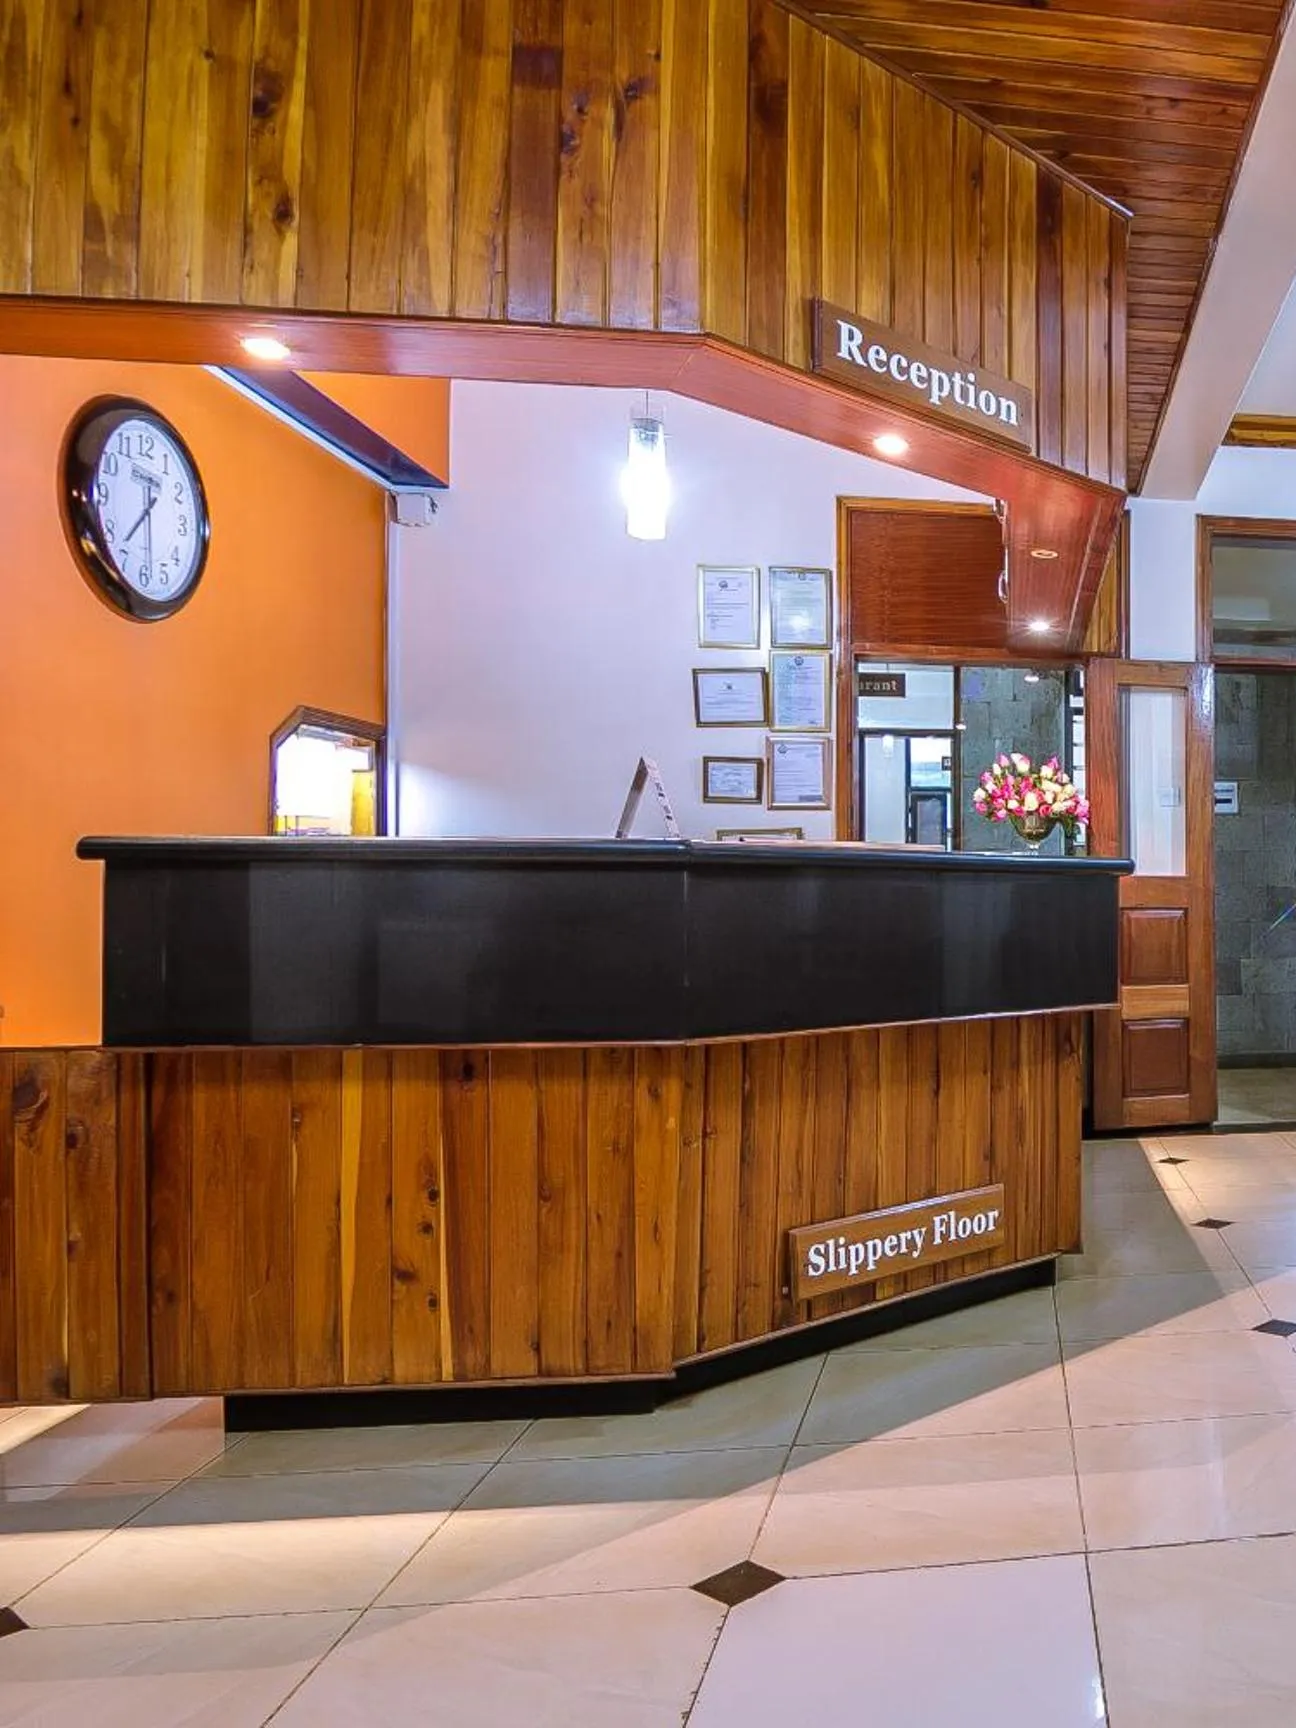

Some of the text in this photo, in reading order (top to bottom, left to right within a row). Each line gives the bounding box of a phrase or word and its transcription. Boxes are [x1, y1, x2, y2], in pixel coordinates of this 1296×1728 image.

[836, 319, 1018, 426] Reception
[117, 432, 133, 459] 11
[138, 434, 155, 460] 12
[102, 452, 118, 477] 10
[162, 453, 170, 476] 1
[100, 481, 110, 506] 9
[174, 482, 184, 505] 2
[105, 519, 116, 544] 8
[178, 514, 188, 537] 3
[120, 548, 129, 573] 7
[171, 546, 180, 567] 4
[139, 564, 150, 588] 6
[160, 563, 169, 586] 5
[807, 1208, 1000, 1277] Slippery Floor
